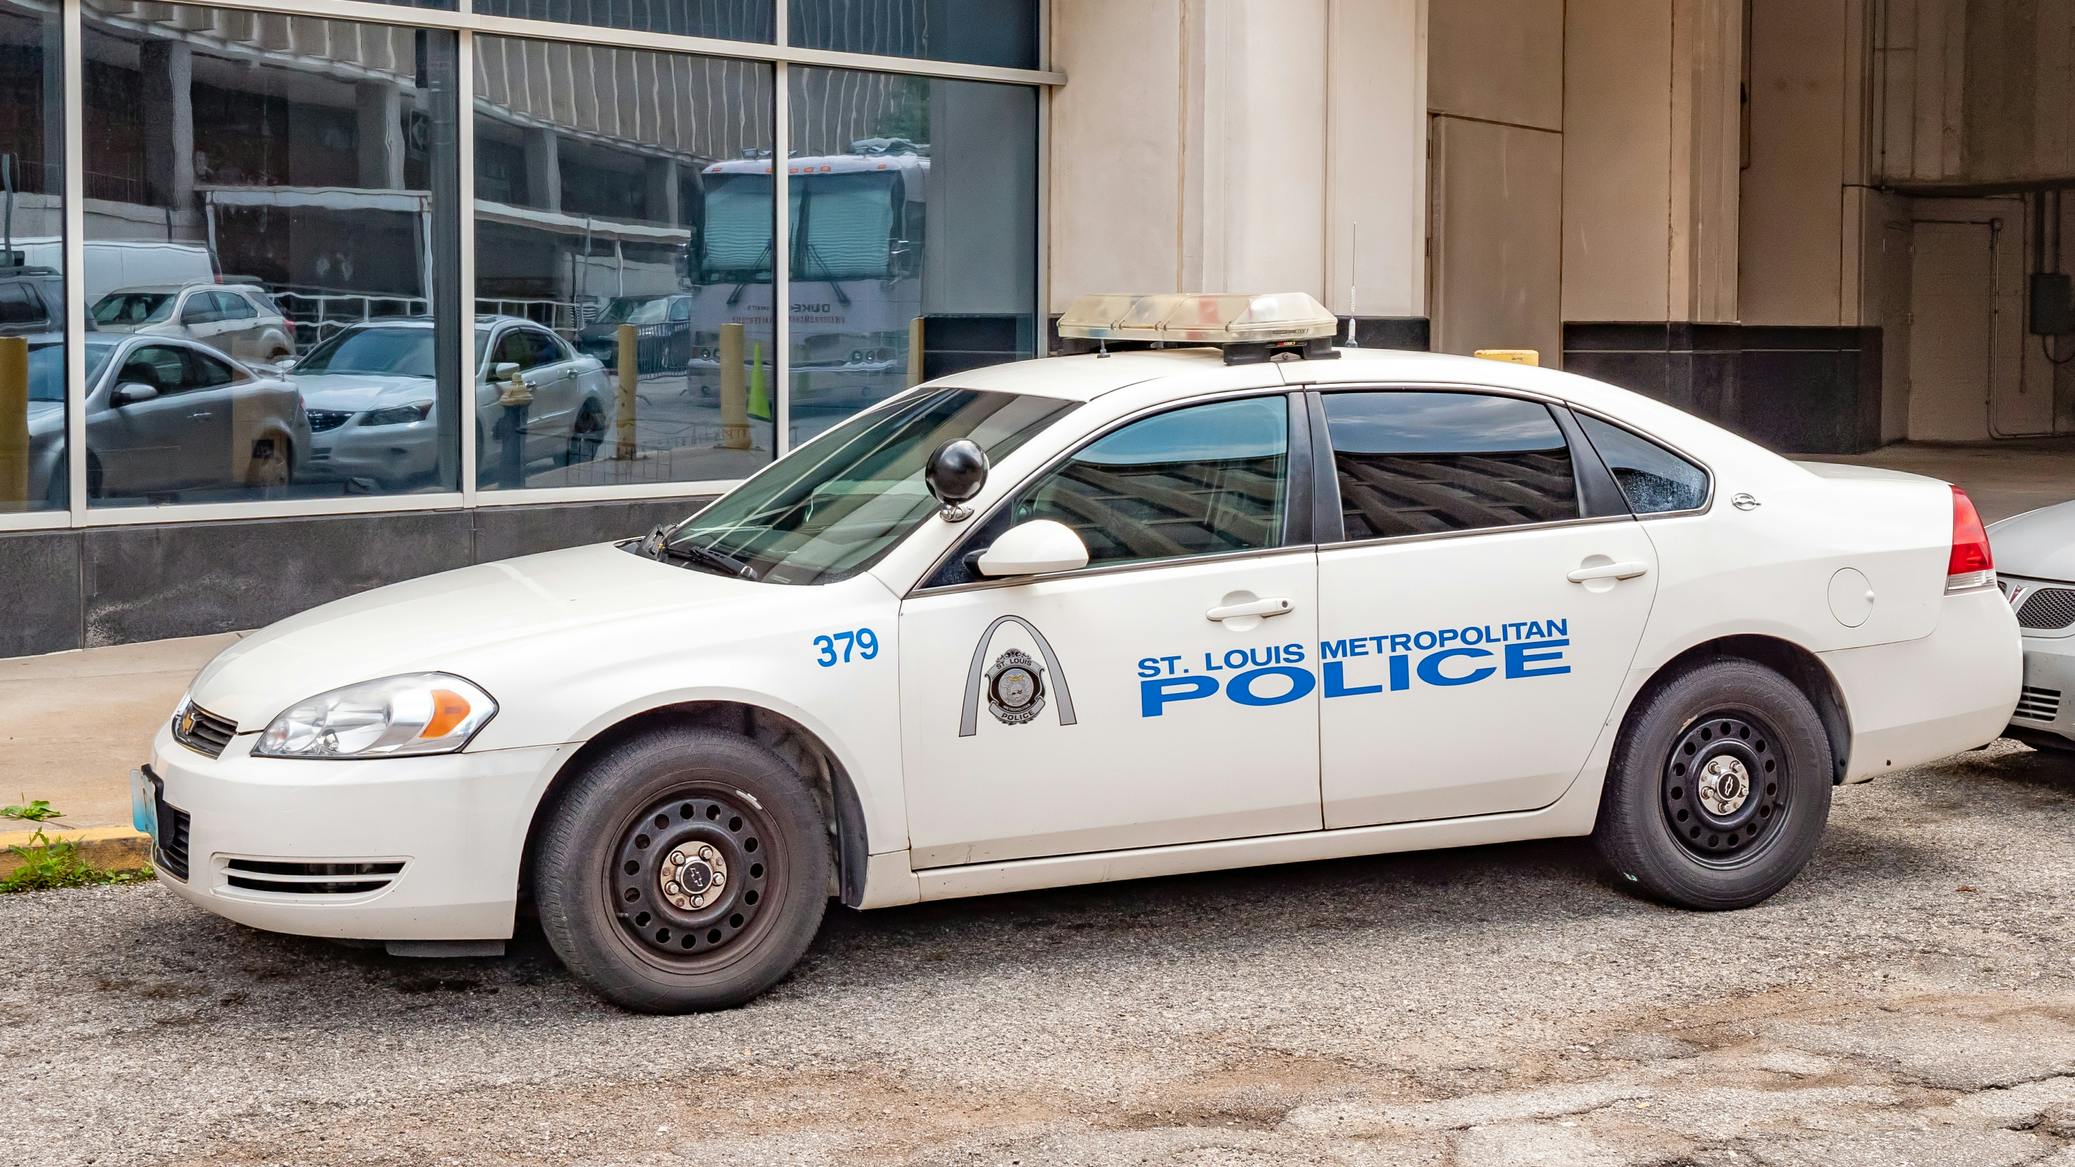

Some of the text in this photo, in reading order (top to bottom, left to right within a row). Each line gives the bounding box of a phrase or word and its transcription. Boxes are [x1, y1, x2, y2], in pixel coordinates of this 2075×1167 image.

[813, 627, 879, 667] 379
[996, 657, 1032, 670] ST. LOUIS
[1138, 618, 1567, 678] ST. LOUIS METROPOLITAN
[1139, 639, 1571, 718] POLICE
[1001, 710, 1034, 721] POLICE
